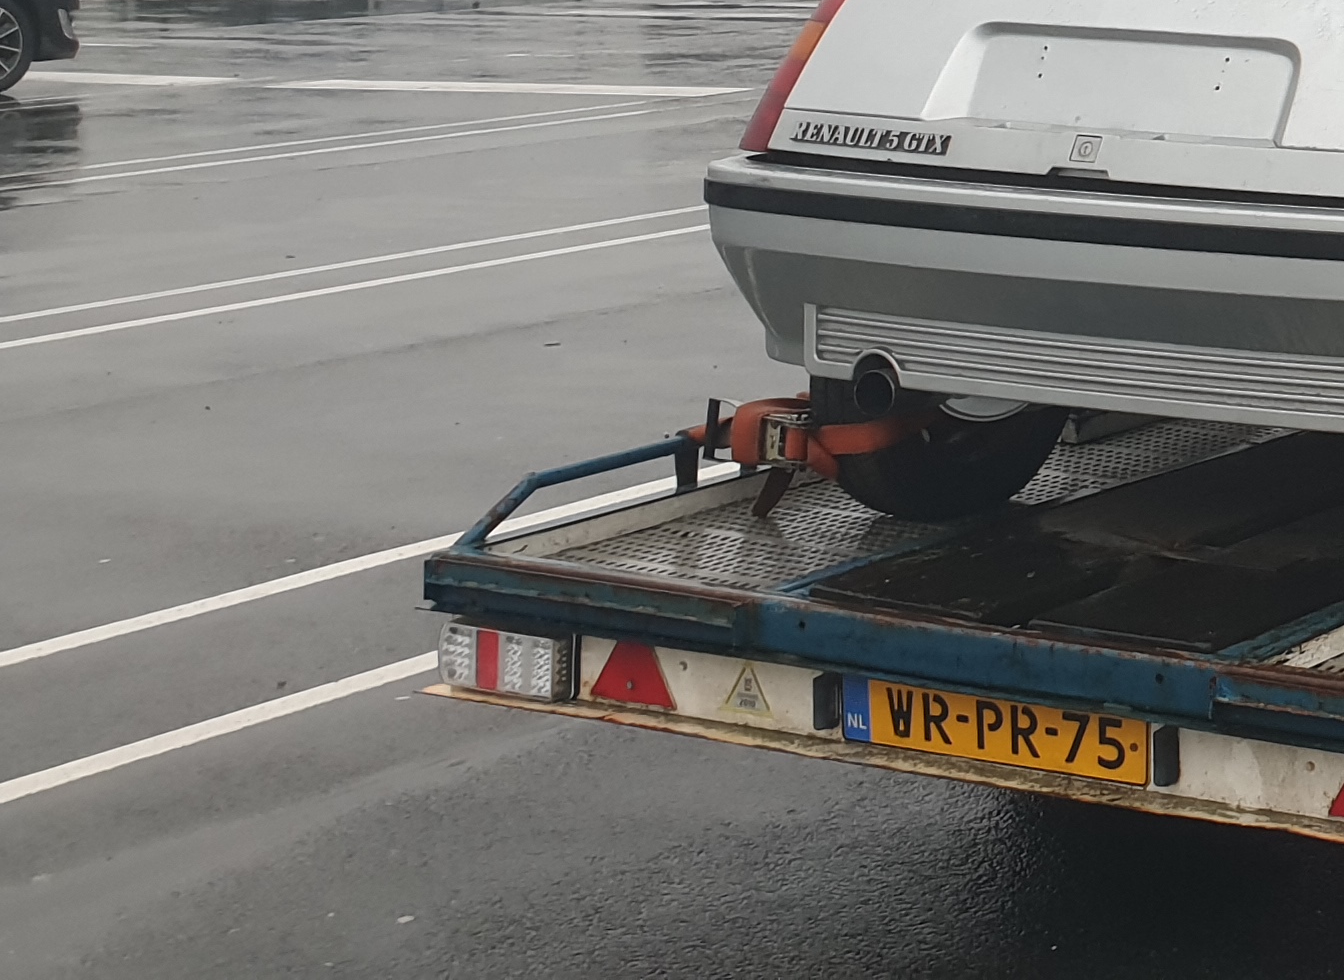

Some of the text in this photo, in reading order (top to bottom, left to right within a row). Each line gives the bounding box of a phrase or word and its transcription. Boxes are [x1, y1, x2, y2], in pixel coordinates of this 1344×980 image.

[792, 121, 948, 154] RENAULT 5 GTX
[847, 712, 867, 731] NL
[886, 686, 1126, 770] WR-PR-75
